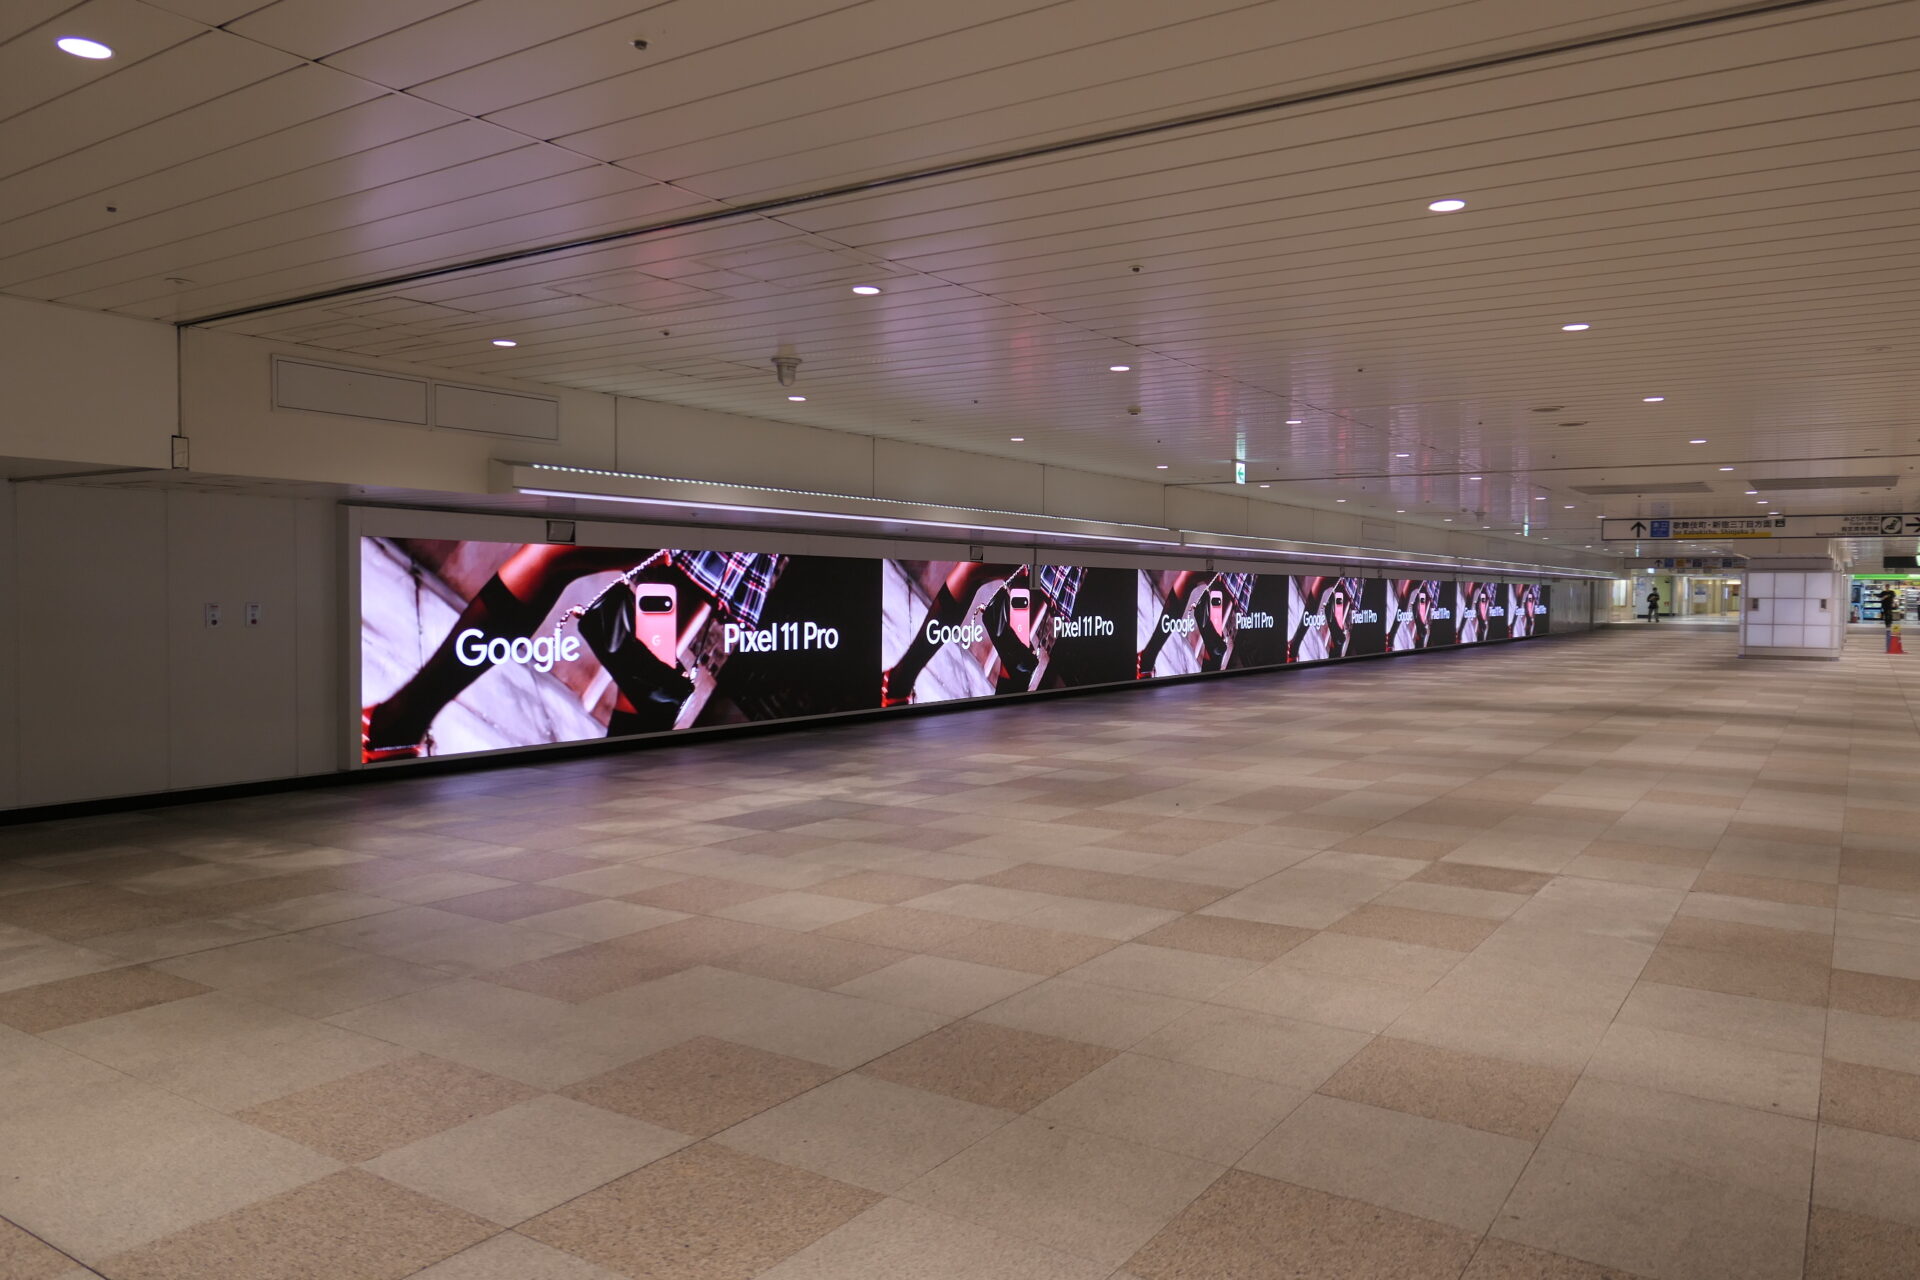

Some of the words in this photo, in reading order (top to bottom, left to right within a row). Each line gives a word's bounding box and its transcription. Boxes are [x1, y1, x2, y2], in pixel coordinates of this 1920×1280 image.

[1053, 616, 1081, 638] Pixel
[1082, 616, 1093, 637] 11
[1094, 615, 1114, 636] Pro
[1161, 614, 1194, 637] Google
[1235, 612, 1254, 630] Pixel
[1254, 612, 1261, 629] 11
[1261, 612, 1274, 628] Pro
[1303, 611, 1325, 630] Google
[724, 623, 777, 653] Pixel
[780, 622, 799, 650] 11
[803, 622, 839, 650] Pro
[926, 619, 983, 649] Google
[456, 628, 580, 672] Google
